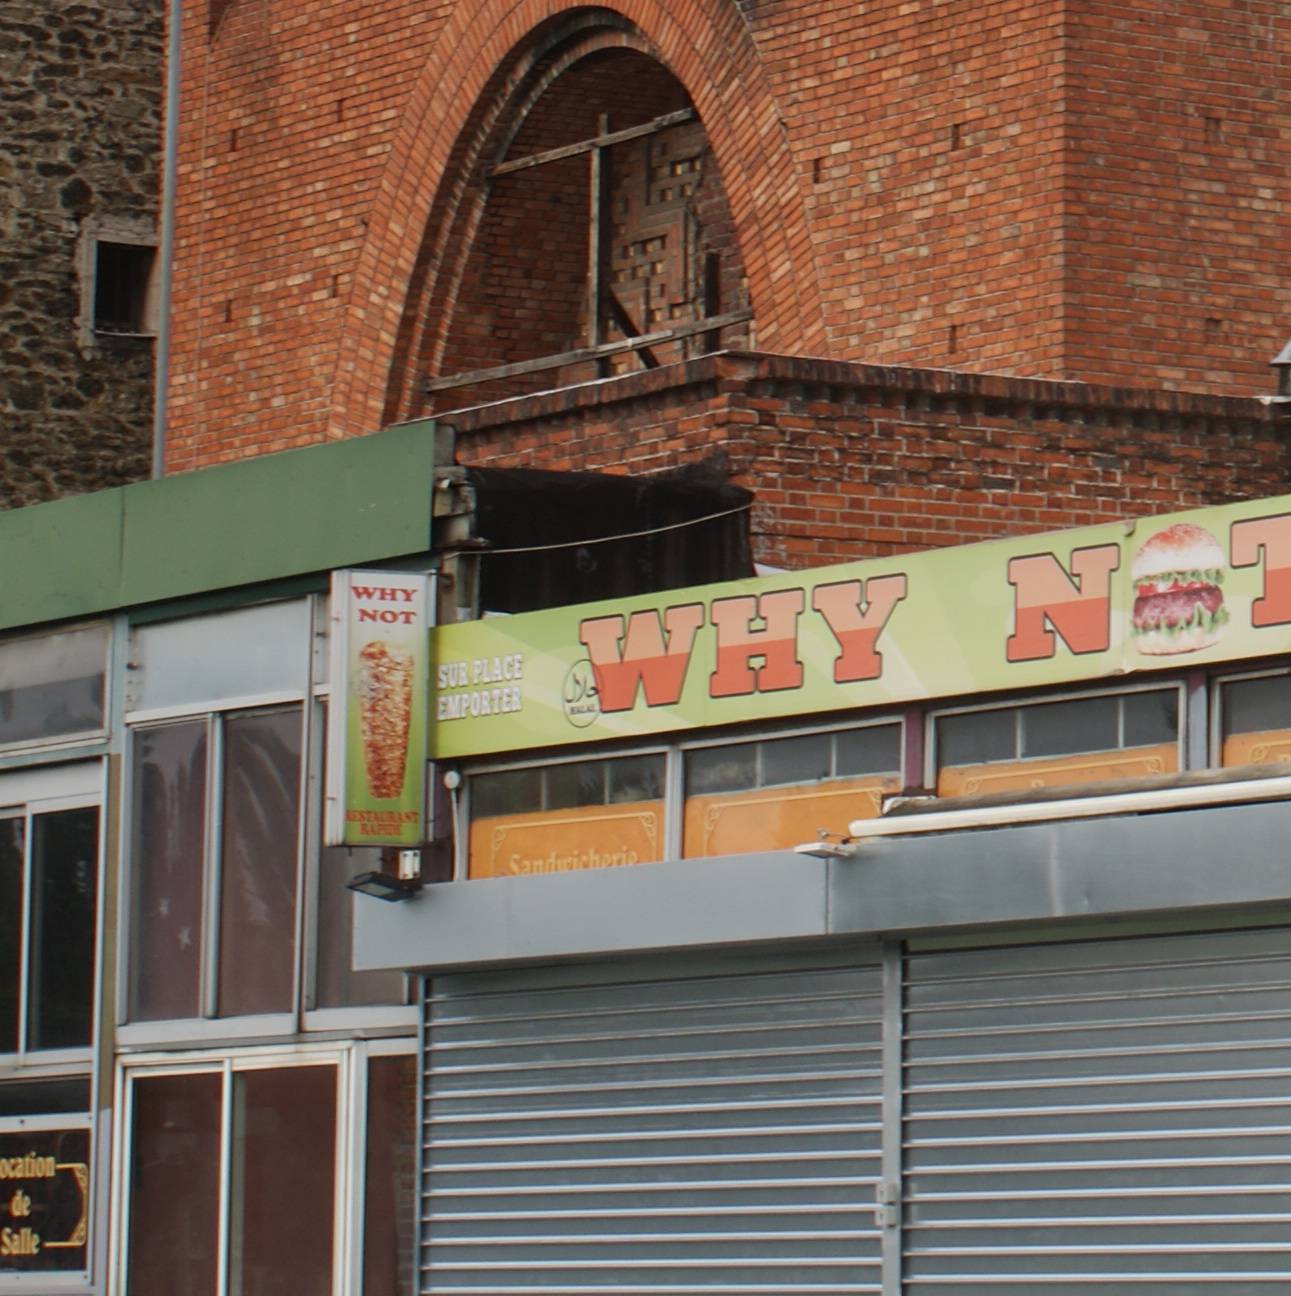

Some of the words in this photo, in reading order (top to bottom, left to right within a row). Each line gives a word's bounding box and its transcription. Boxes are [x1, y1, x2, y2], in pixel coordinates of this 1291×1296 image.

[352, 586, 418, 602] WHY
[358, 608, 417, 625] NOT
[579, 572, 908, 713] WHY
[438, 662, 468, 689] SUR
[473, 653, 523, 685] PLACE
[437, 686, 521, 720] EMPORTER
[0, 1151, 56, 1179] ocation
[11, 1189, 31, 1217] de
[0, 1227, 40, 1255] Salle
